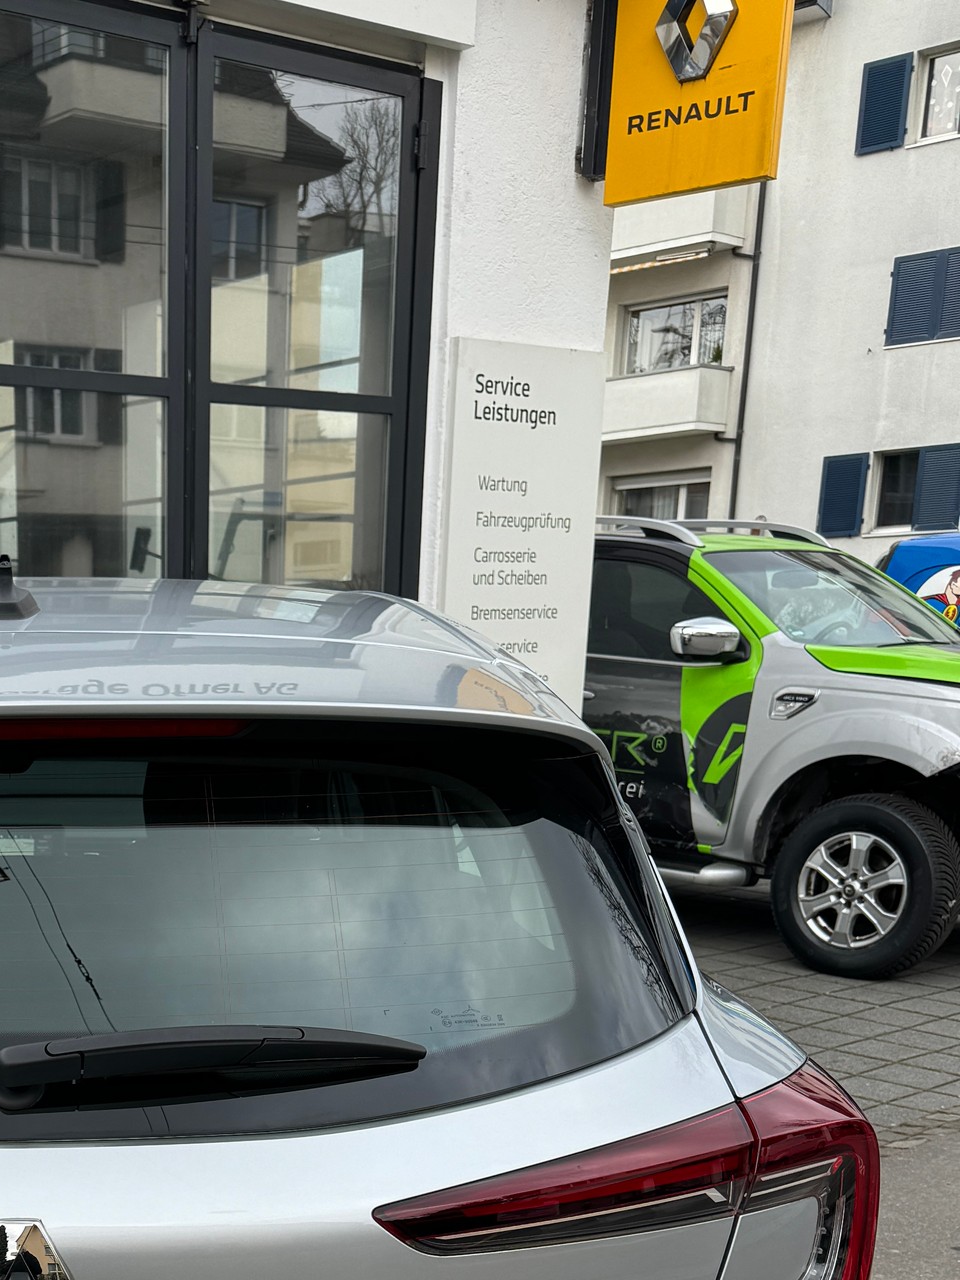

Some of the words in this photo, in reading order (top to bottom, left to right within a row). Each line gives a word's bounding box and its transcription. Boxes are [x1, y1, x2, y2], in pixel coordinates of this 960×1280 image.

[627, 90, 755, 135] RENAULT
[475, 373, 531, 398] Service
[474, 400, 557, 429] Leistungen
[478, 475, 528, 497] Wartung
[475, 511, 572, 533] Fahrzeugprüfung
[473, 546, 537, 564] Carrosserie
[472, 570, 495, 586] und
[497, 570, 548, 587] Scheiben
[471, 605, 559, 622] Bremsenservice
[496, 638, 539, 655] service
